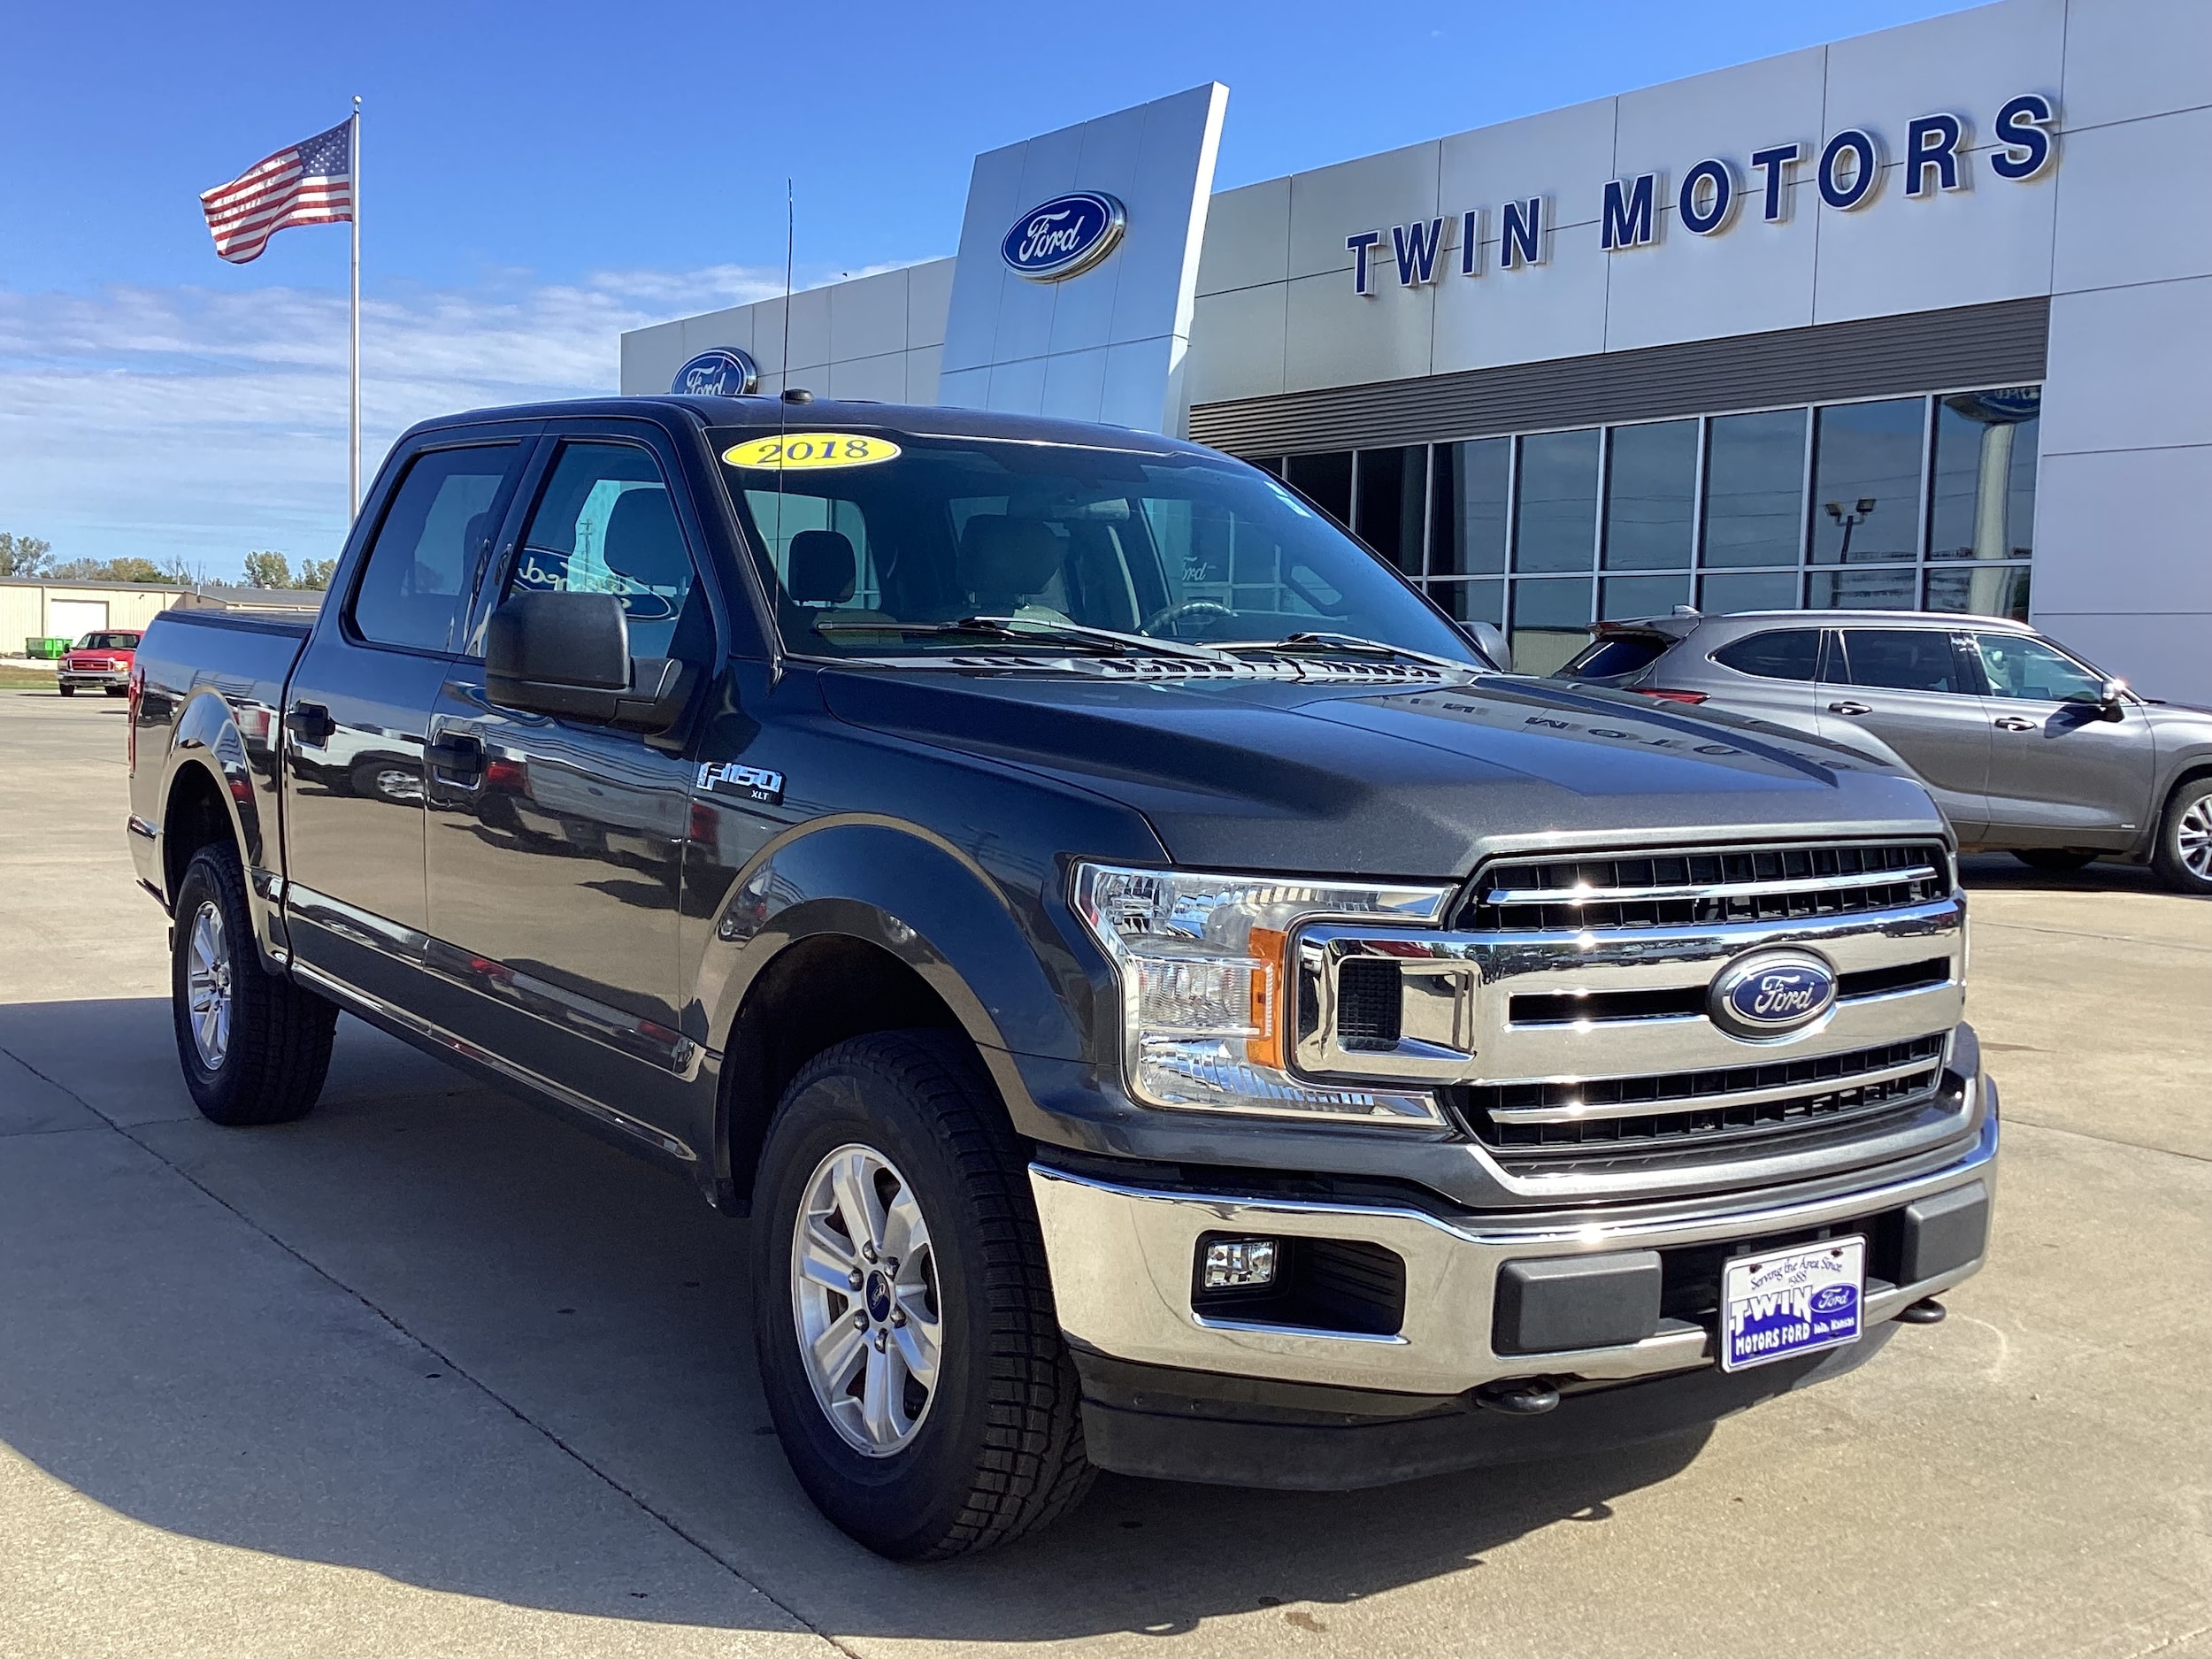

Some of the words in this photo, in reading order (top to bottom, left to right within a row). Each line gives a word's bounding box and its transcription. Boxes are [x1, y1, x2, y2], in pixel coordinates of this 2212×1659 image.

[1345, 194, 1550, 296] TWIN
[1601, 94, 2060, 252] MOTORS
[1018, 210, 1085, 262] Ford
[684, 365, 726, 395] Ford
[757, 439, 869, 465] 2018
[750, 789, 770, 801] XLT
[1755, 975, 1816, 1014] Ford
[1750, 1266, 1783, 1291] Serving
[1784, 1256, 1799, 1274] the
[1800, 1256, 1820, 1270] Area
[1821, 1256, 1843, 1272] Since
[1729, 1285, 1813, 1336] TWIN
[1818, 1288, 1849, 1310] Ford
[1735, 1327, 1780, 1356] MOTORS
[1782, 1322, 1811, 1345] FORD
